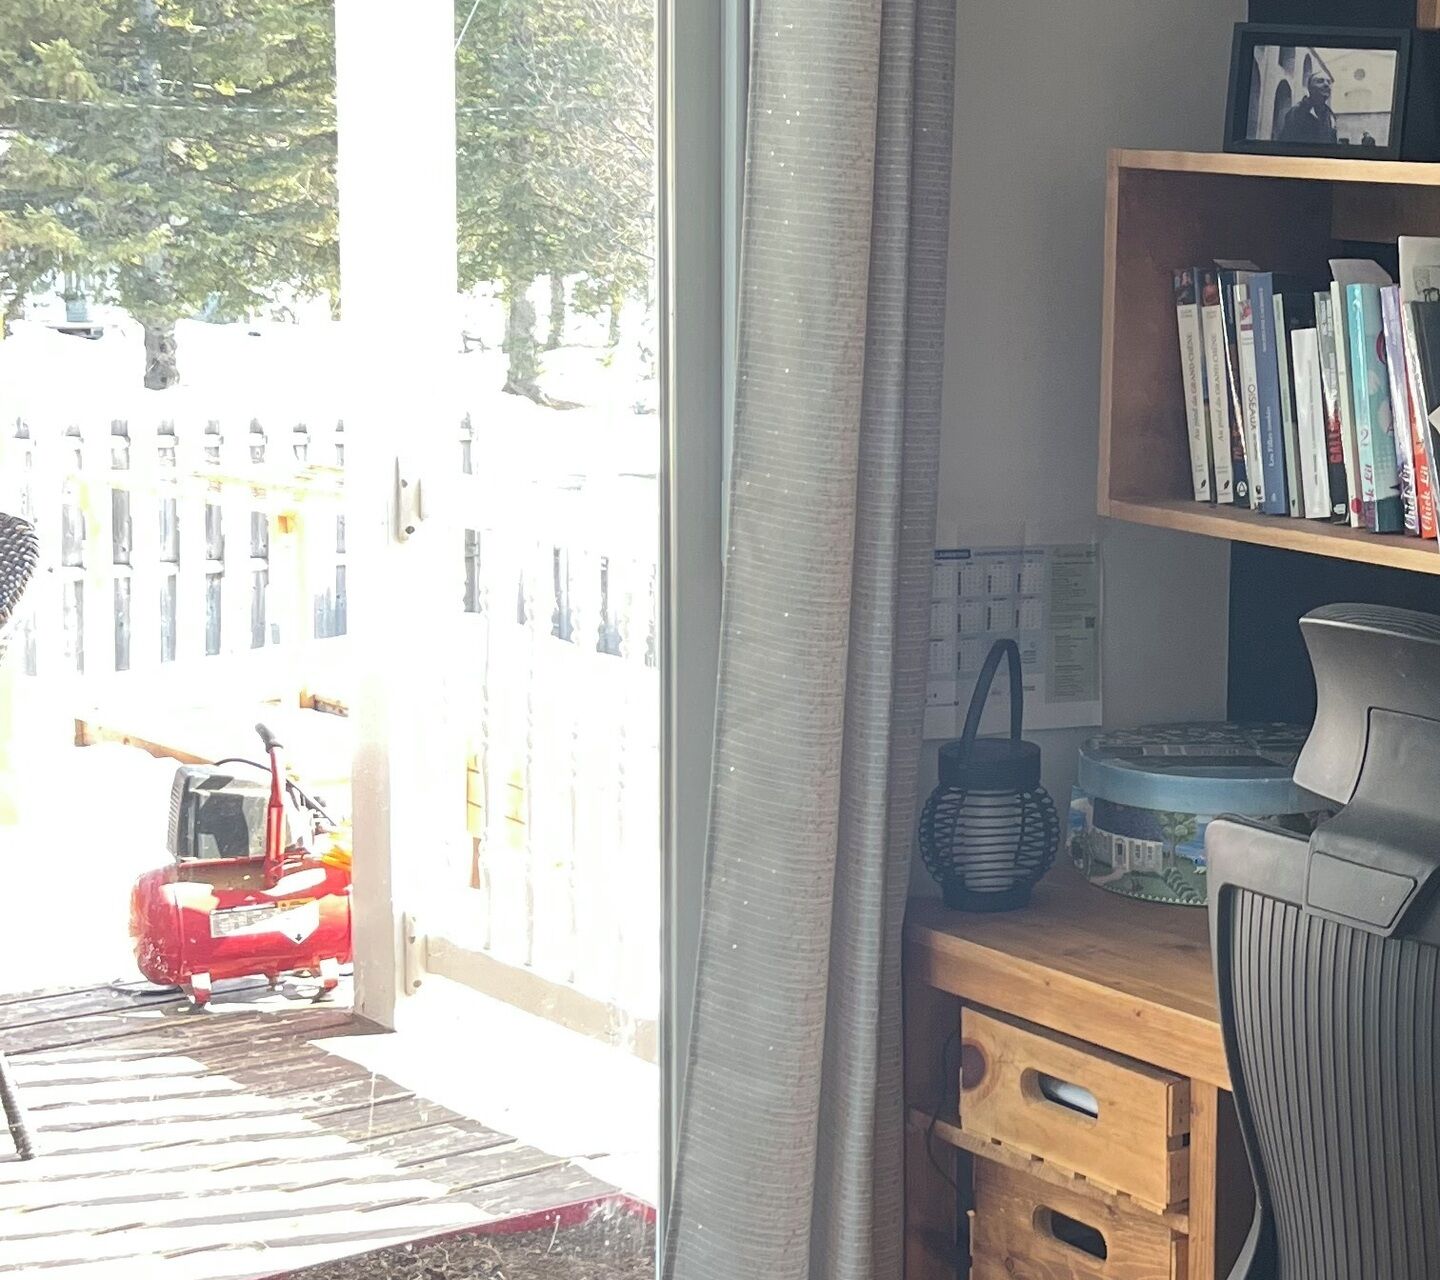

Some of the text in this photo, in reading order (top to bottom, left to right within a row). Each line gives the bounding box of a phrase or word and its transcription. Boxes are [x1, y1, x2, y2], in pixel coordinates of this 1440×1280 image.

[1247, 384, 1257, 430] OISEAUX
[1266, 432, 1274, 452] Filles
[1364, 463, 1373, 486] Lit
[1420, 464, 1433, 531] Chick Lit
[1400, 482, 1416, 530] Chick
